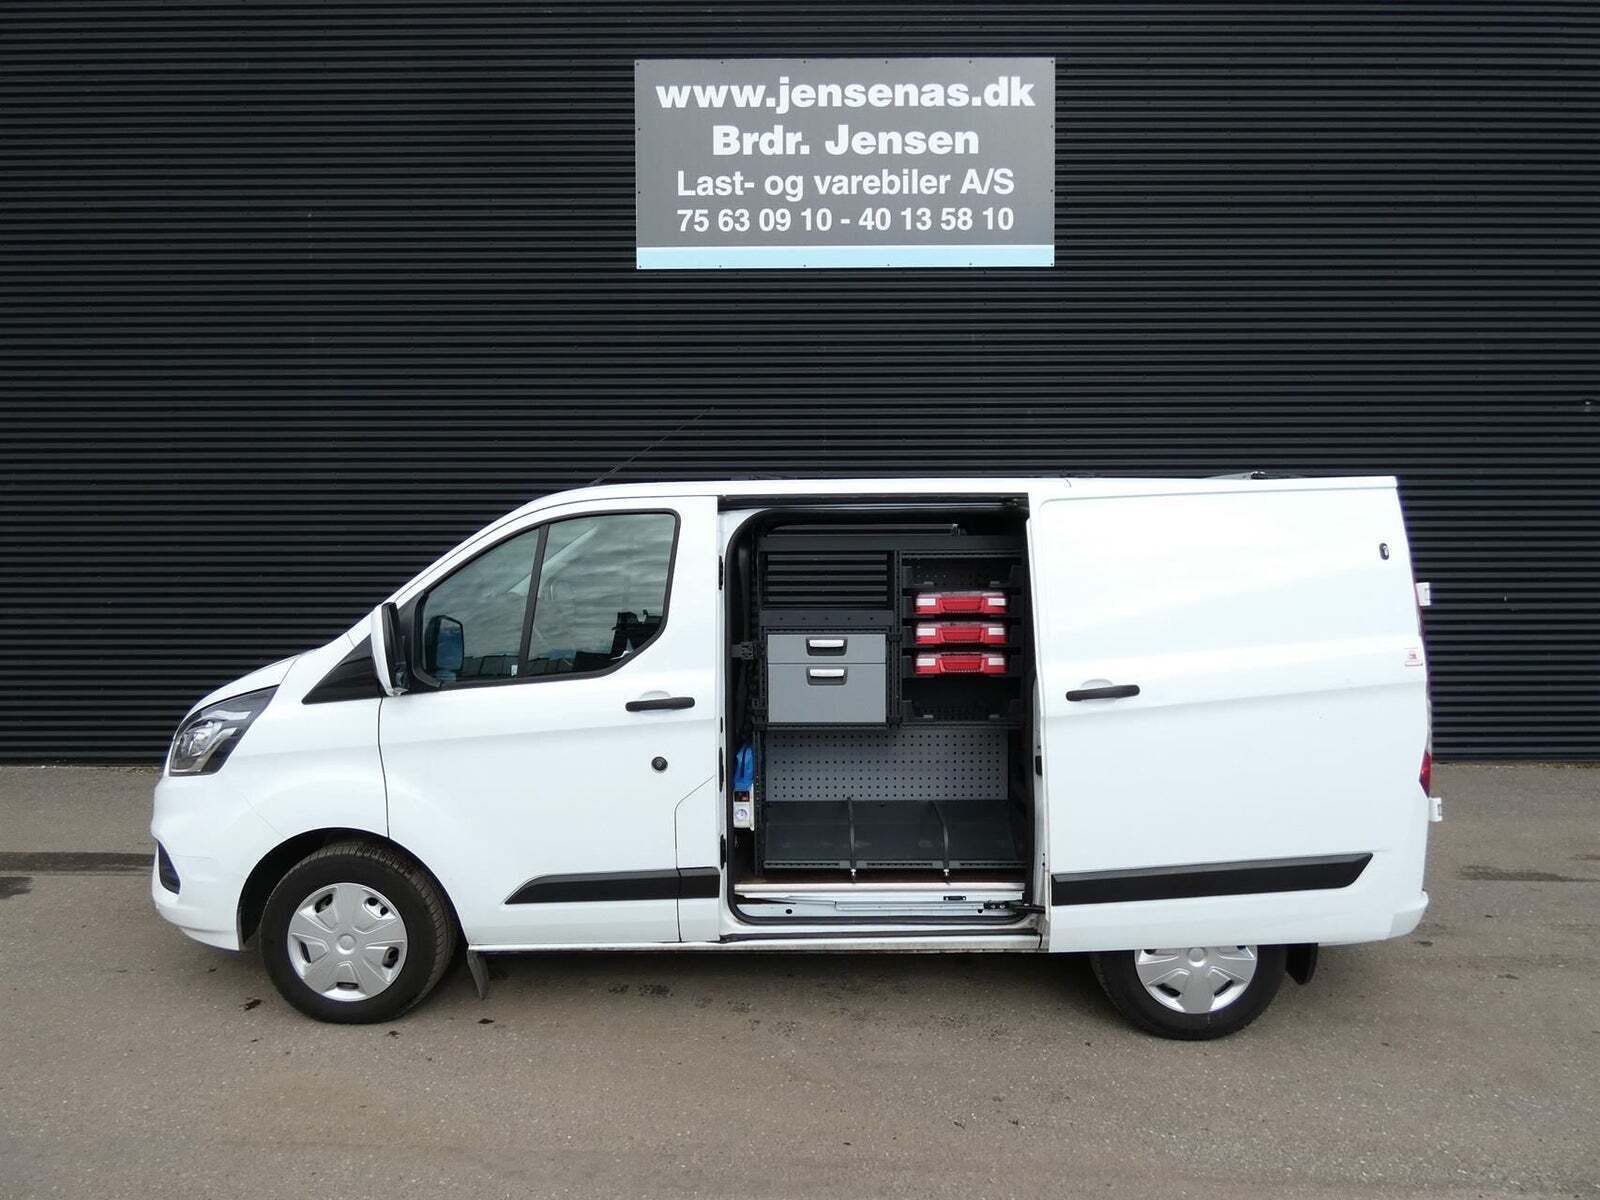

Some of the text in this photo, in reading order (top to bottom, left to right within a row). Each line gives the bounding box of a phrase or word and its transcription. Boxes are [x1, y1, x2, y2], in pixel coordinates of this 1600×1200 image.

[656, 76, 1036, 114] www.jensenas.dk
[713, 124, 979, 155] Brdr. Jensen
[678, 168, 1014, 202] Last- og varebiler A/S
[677, 209, 709, 232] 75
[718, 209, 750, 231] 63
[759, 208, 791, 231] 09
[801, 208, 832, 231] 10
[859, 208, 891, 230] 40
[901, 208, 932, 230] 13
[941, 208, 973, 230] 58
[983, 207, 1013, 230] 10
